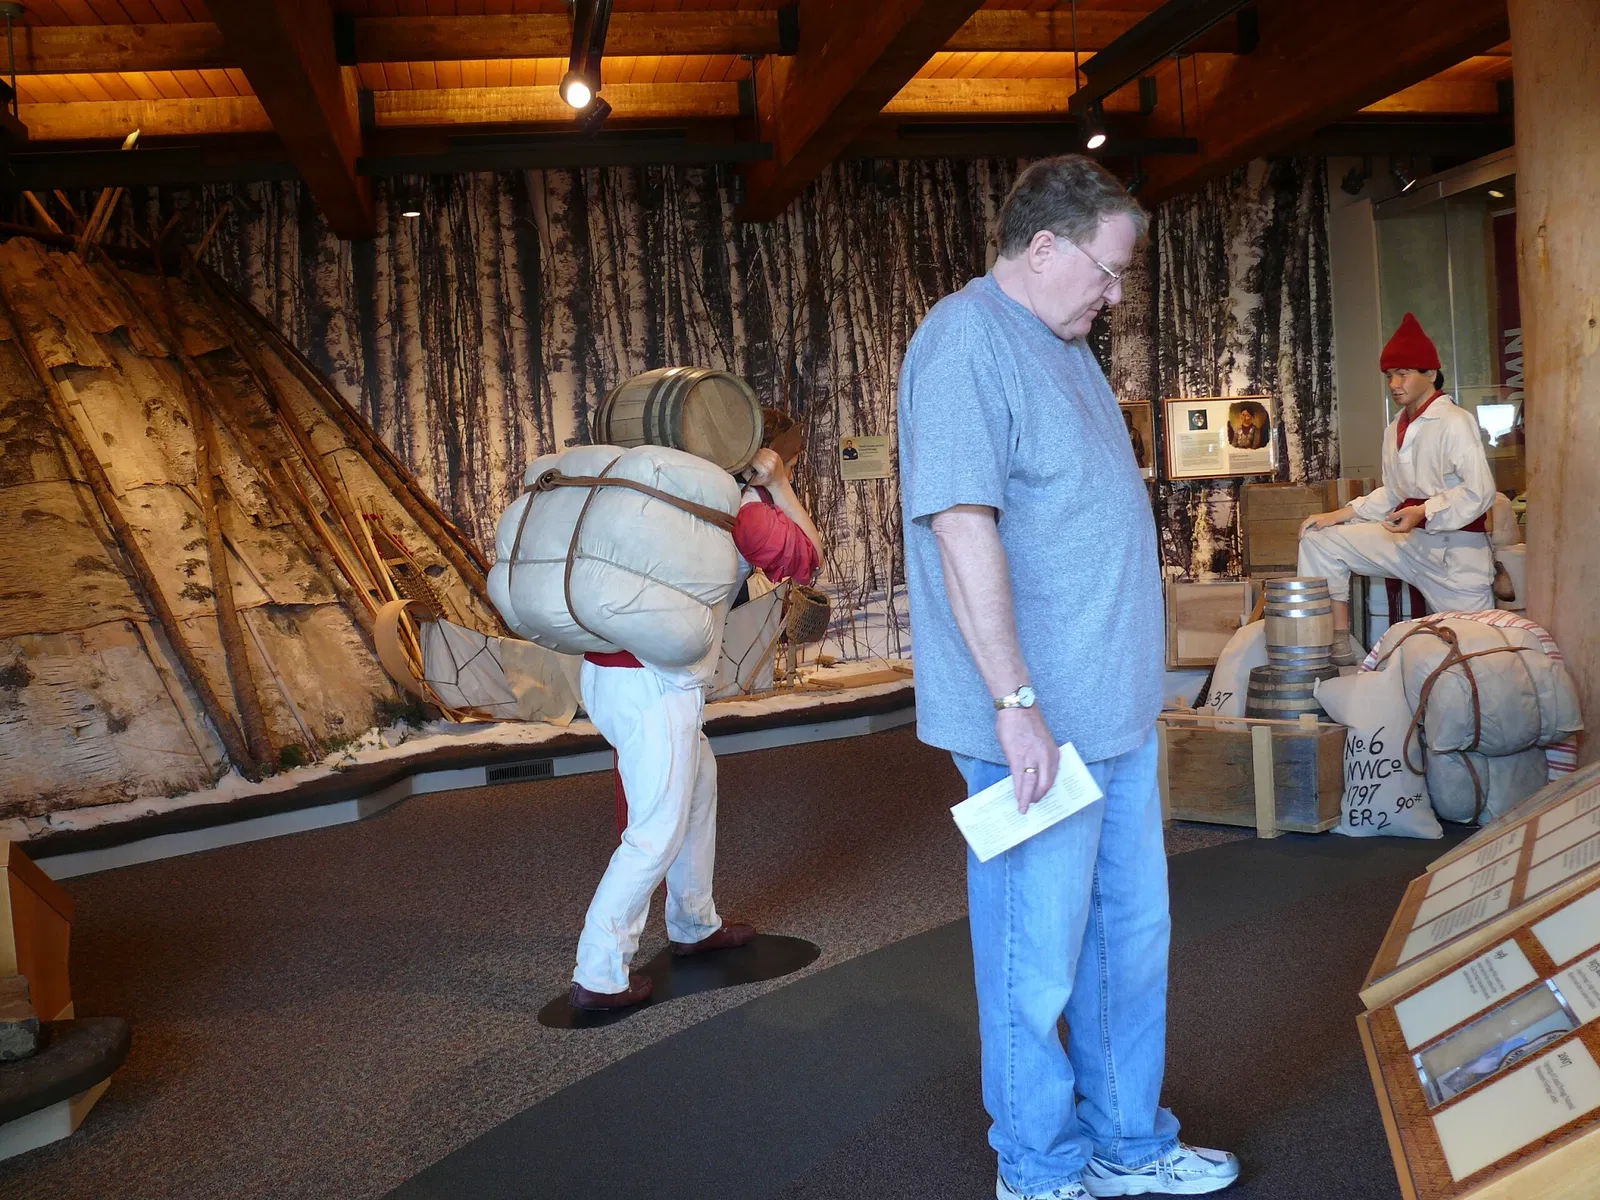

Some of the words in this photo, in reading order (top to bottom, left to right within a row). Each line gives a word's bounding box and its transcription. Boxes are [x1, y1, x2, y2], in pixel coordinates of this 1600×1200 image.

[1210, 691, 1233, 711] 37
[1369, 726, 1385, 755] 6
[1346, 784, 1381, 807] 1797
[1349, 809, 1375, 827] ER
[1377, 811, 1391, 830] 2
